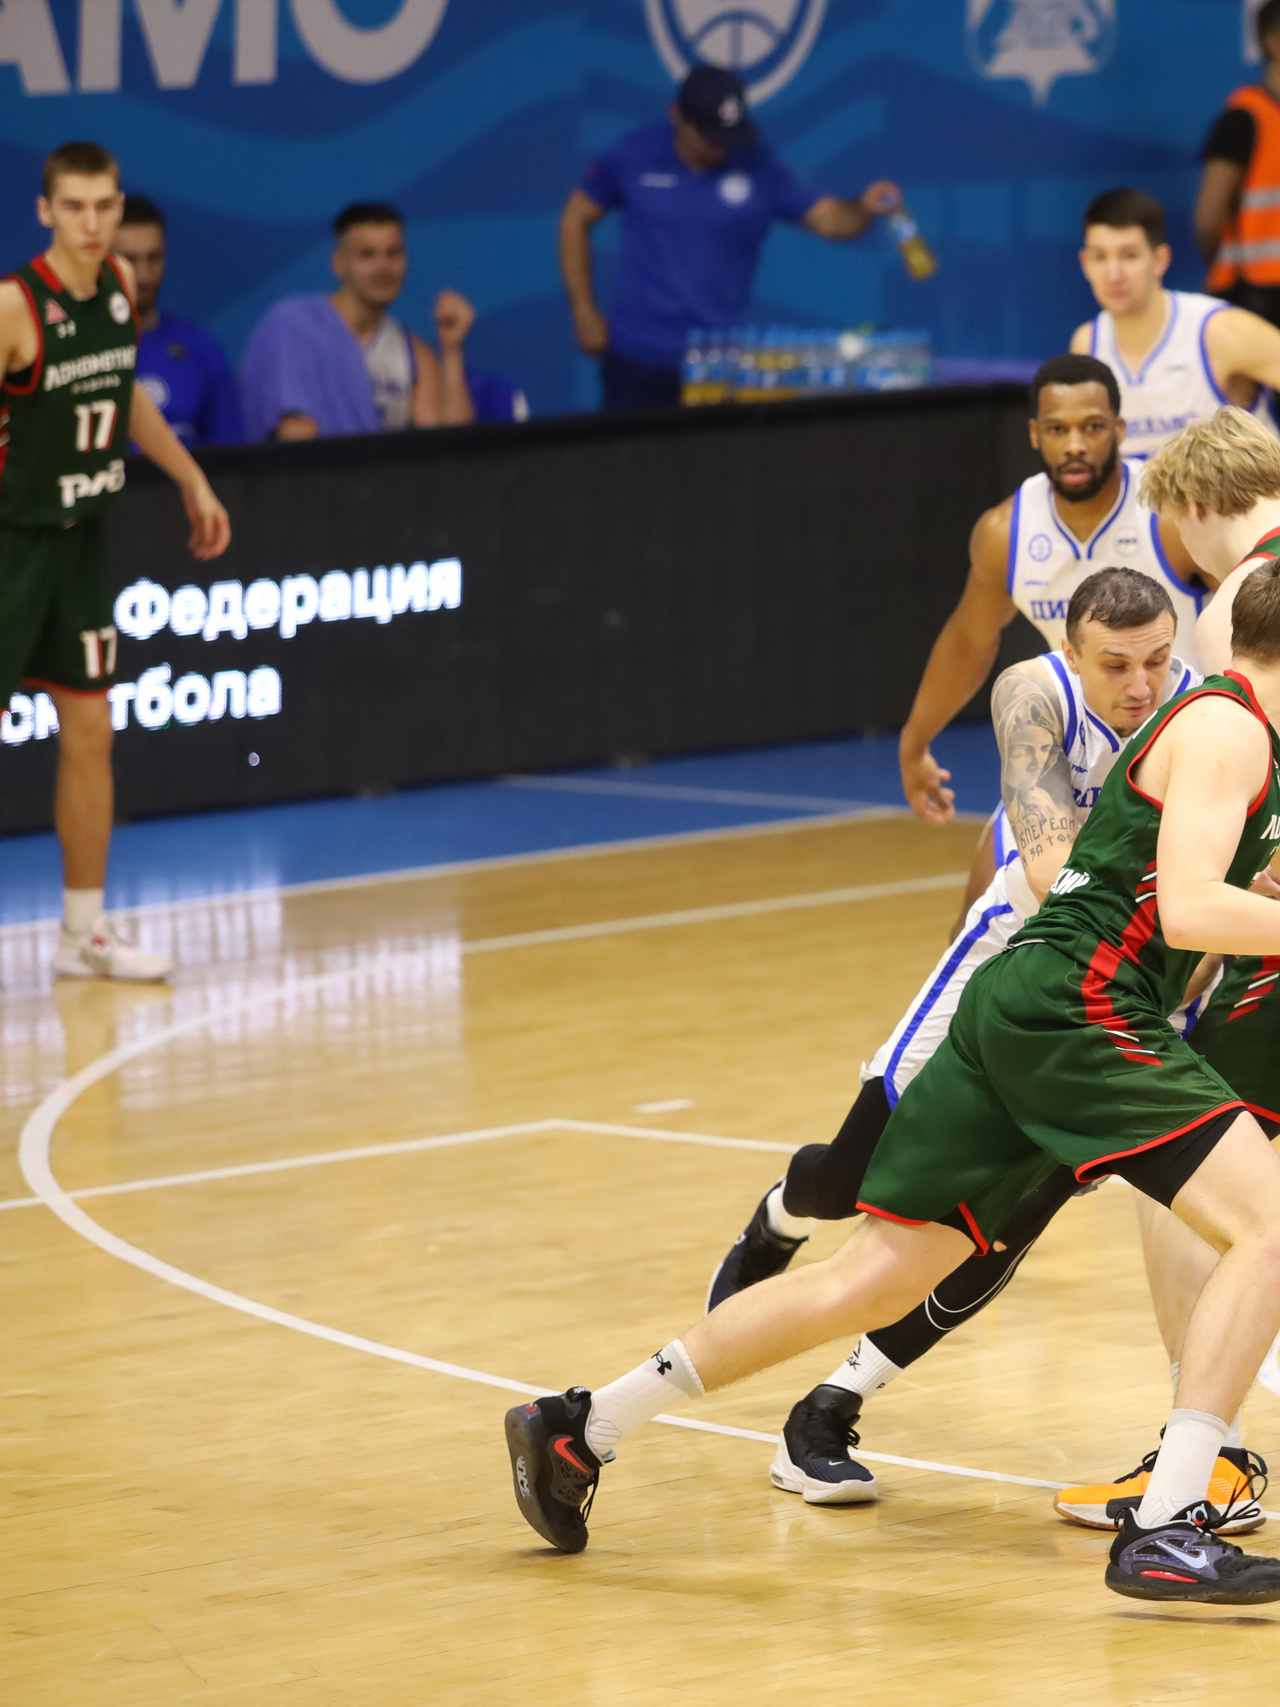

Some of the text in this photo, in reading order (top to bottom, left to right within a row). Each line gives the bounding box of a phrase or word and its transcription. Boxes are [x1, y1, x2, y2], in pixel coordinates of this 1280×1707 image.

[74, 399, 119, 453] 17
[113, 556, 463, 641] Федерация
[80, 625, 117, 679] 17
